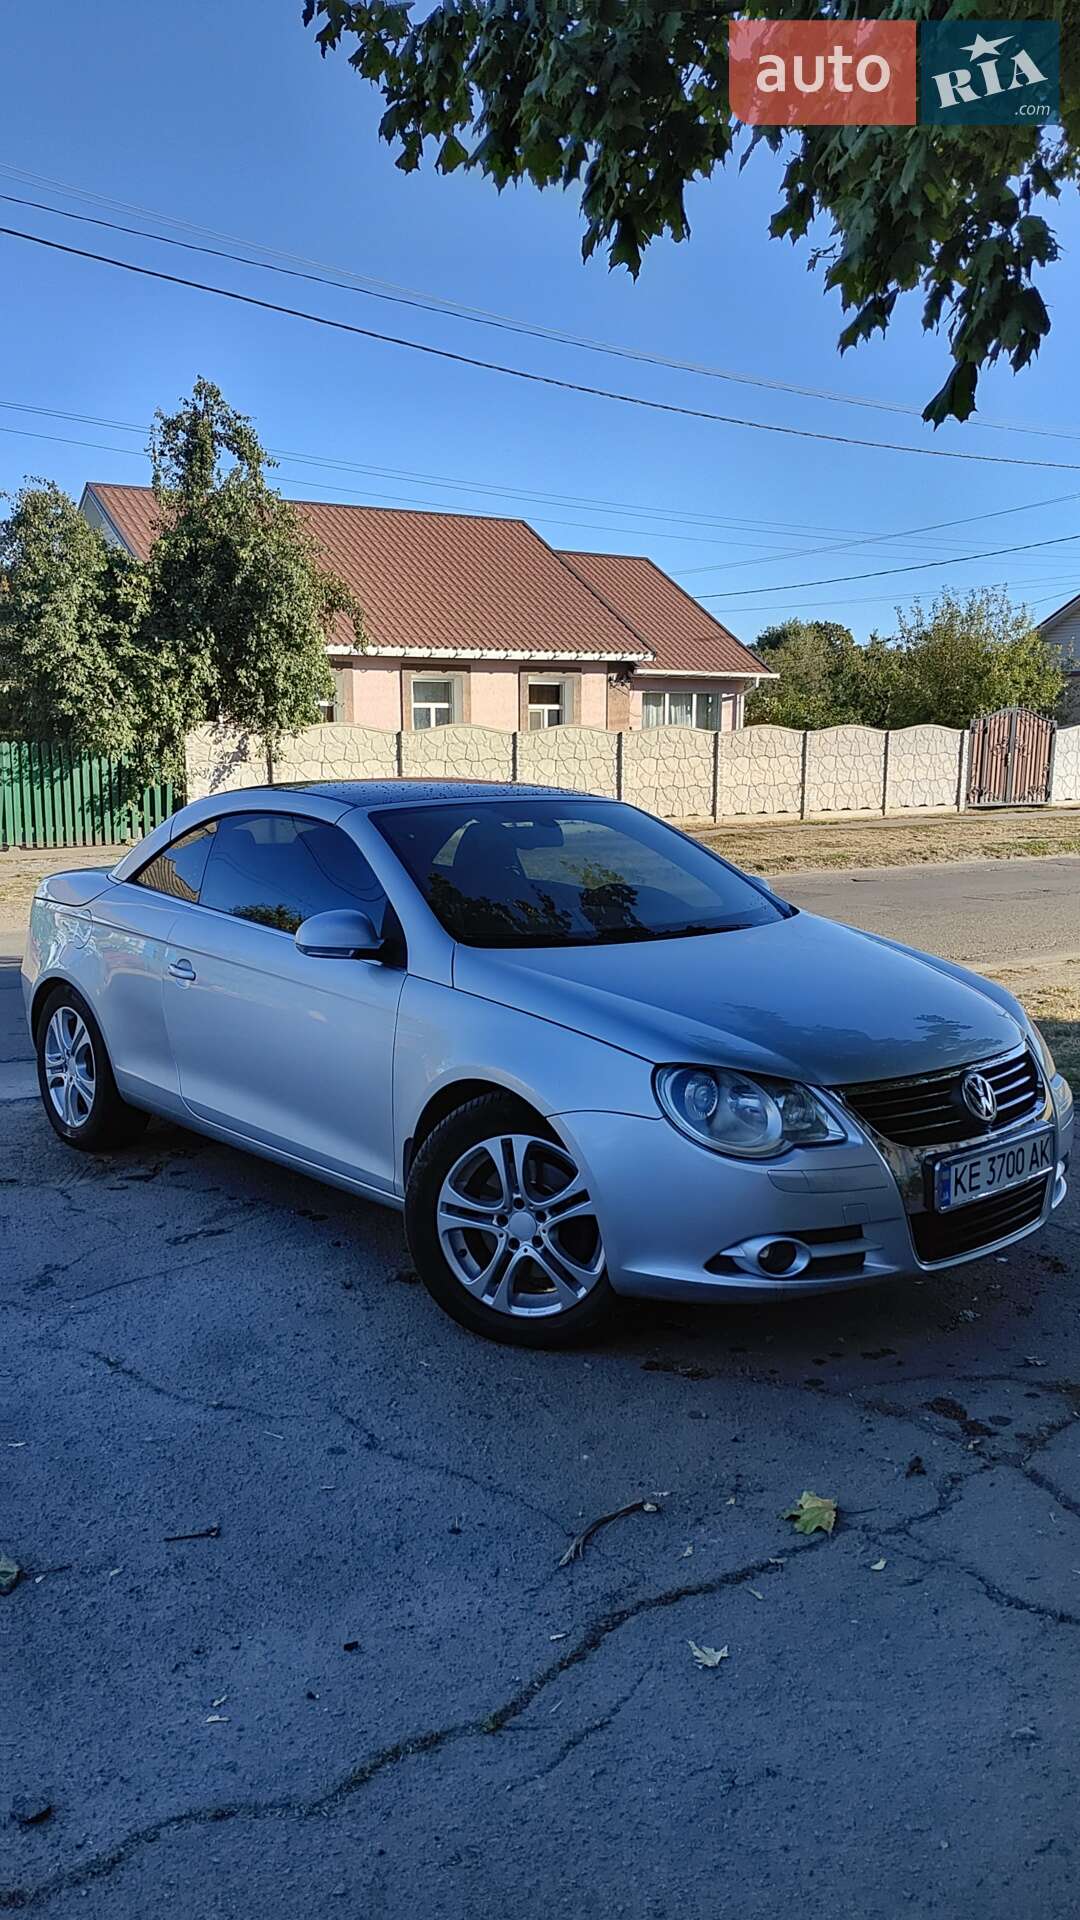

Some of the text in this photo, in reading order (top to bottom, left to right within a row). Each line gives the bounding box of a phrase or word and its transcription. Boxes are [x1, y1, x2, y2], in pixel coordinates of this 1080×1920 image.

[954, 1139, 1050, 1196] KE 3700 AK
